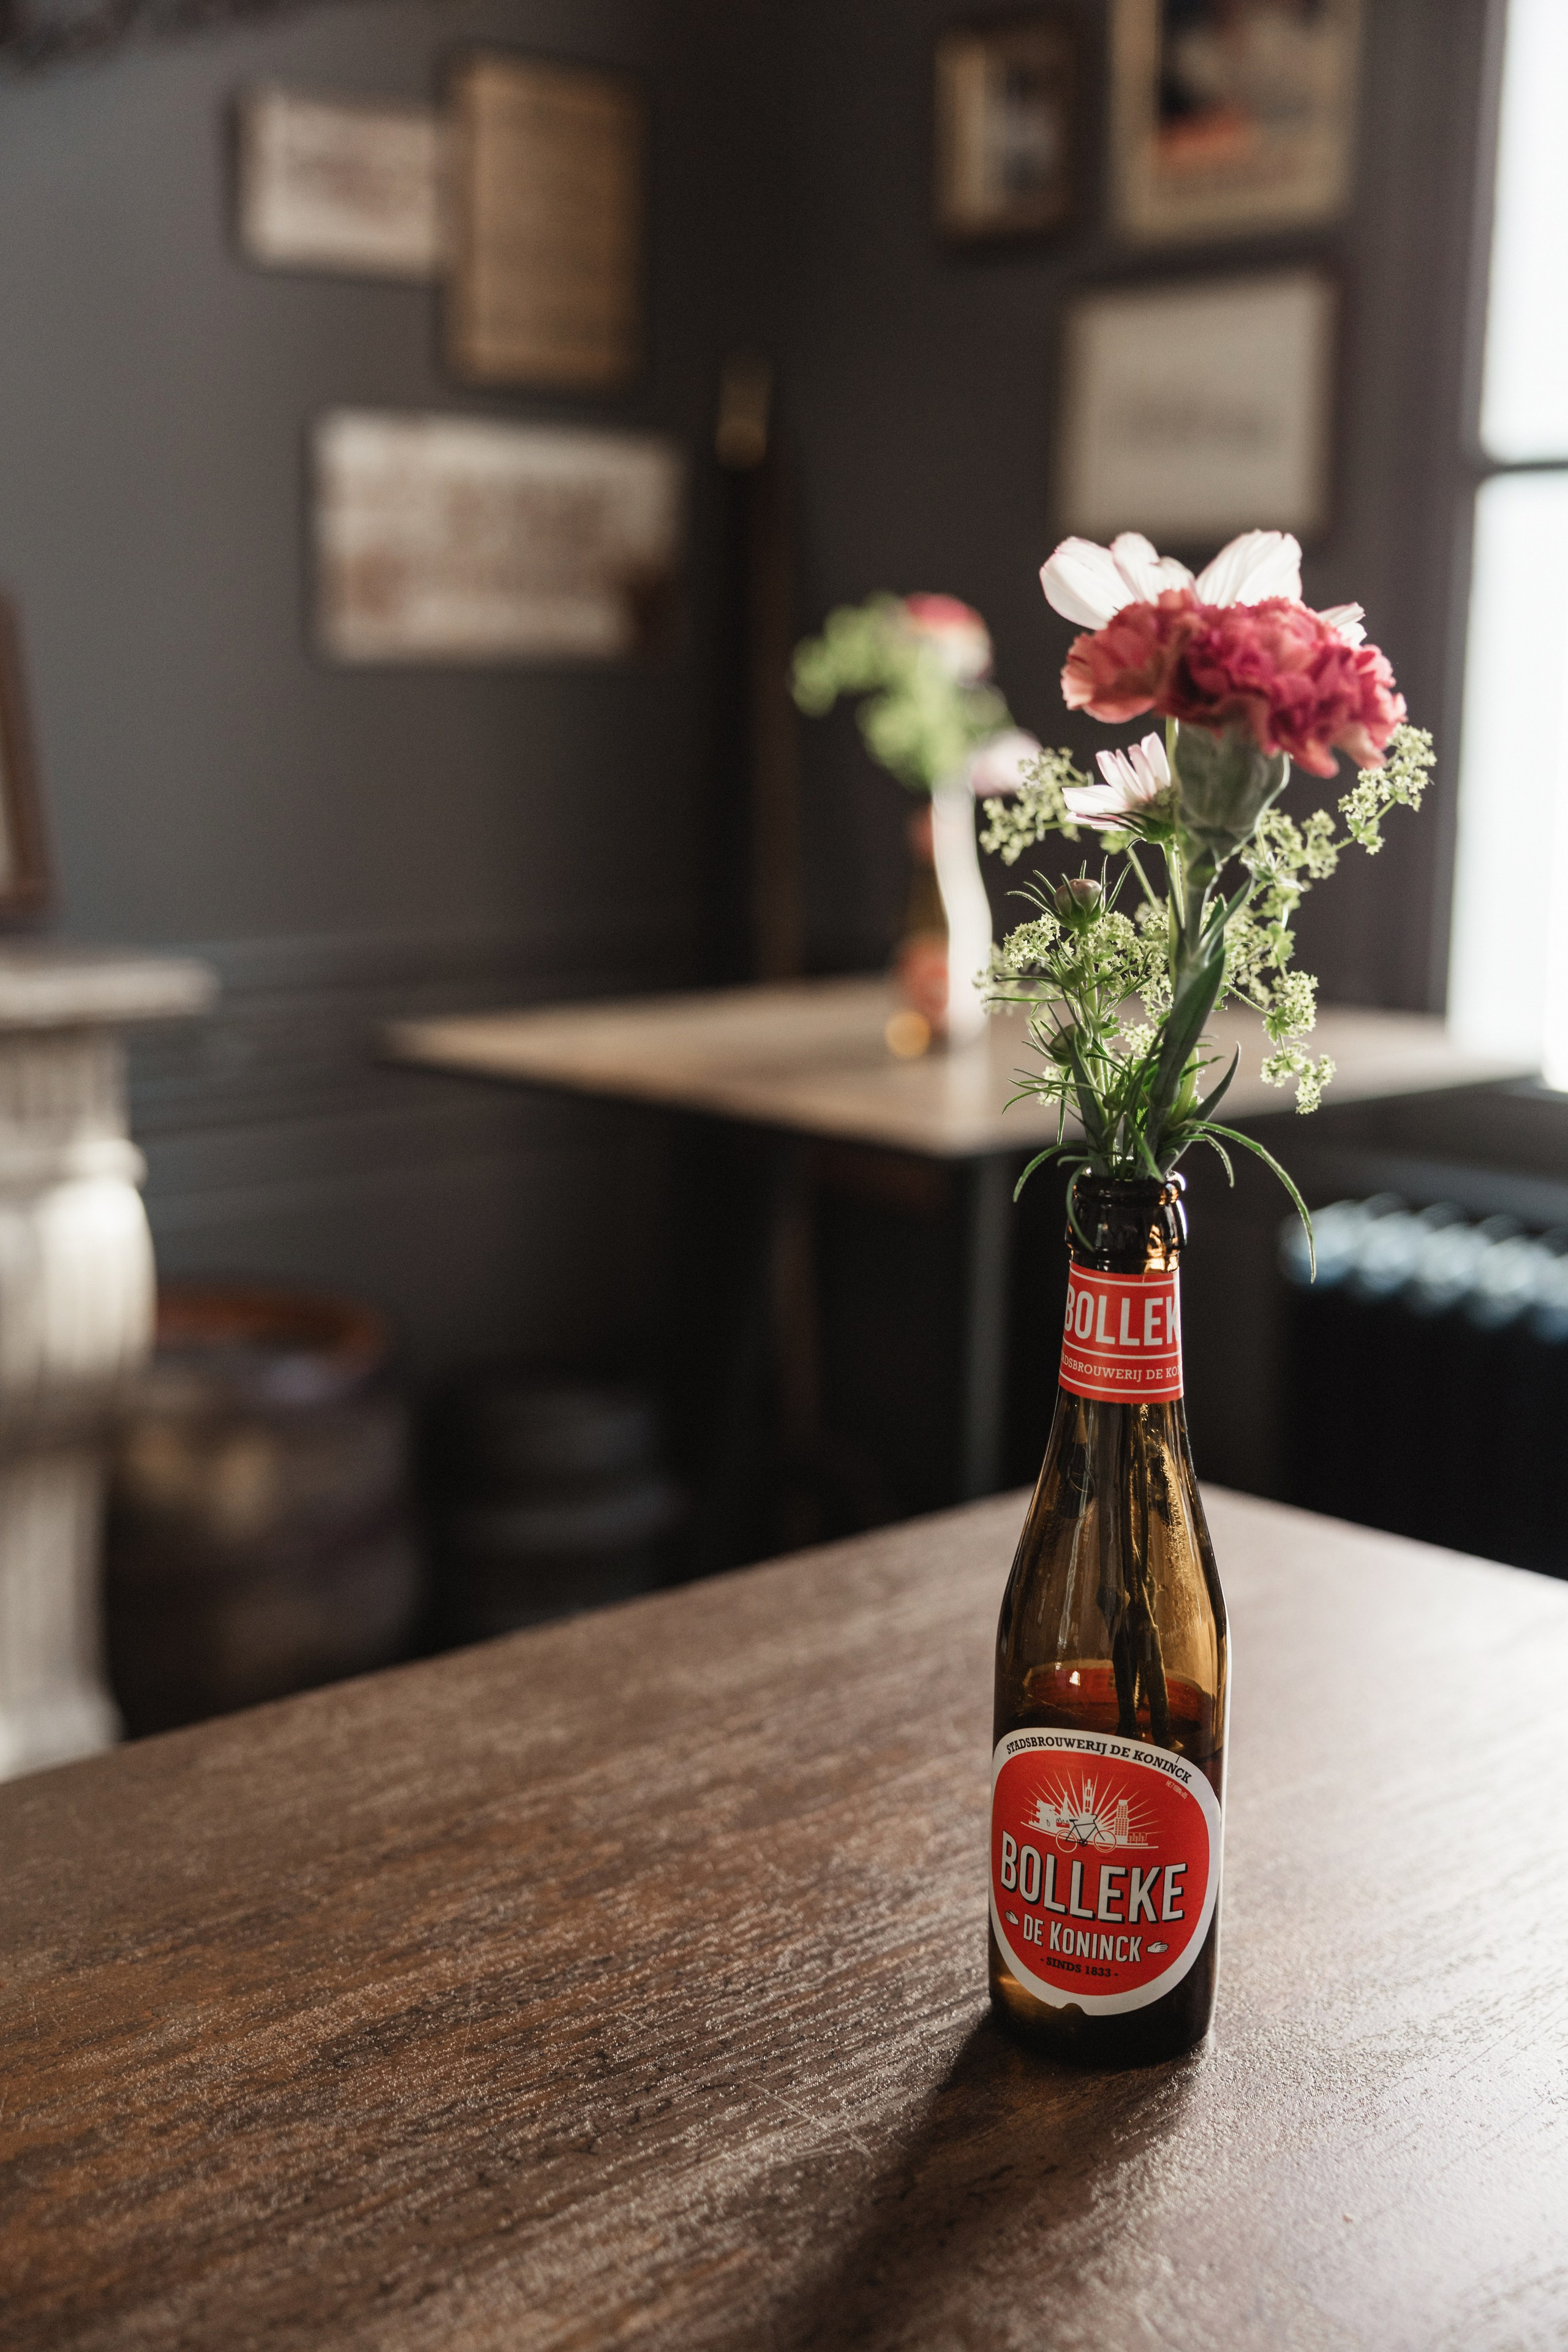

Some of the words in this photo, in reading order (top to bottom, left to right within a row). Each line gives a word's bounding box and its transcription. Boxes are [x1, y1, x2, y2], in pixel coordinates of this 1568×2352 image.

[1145, 1368, 1163, 1380] DE
[1006, 1736, 1107, 1755] STADSBROUWERIJ
[1109, 1744, 1131, 1758] DE
[1132, 1749, 1192, 1784] KONINCK
[1001, 1830, 1188, 1924] BOLLEKE
[1023, 1913, 1044, 1946] DE
[1049, 1920, 1142, 1962] KONINCK
[1046, 1956, 1082, 1973] SINDS
[1085, 1966, 1112, 1978] 1833
